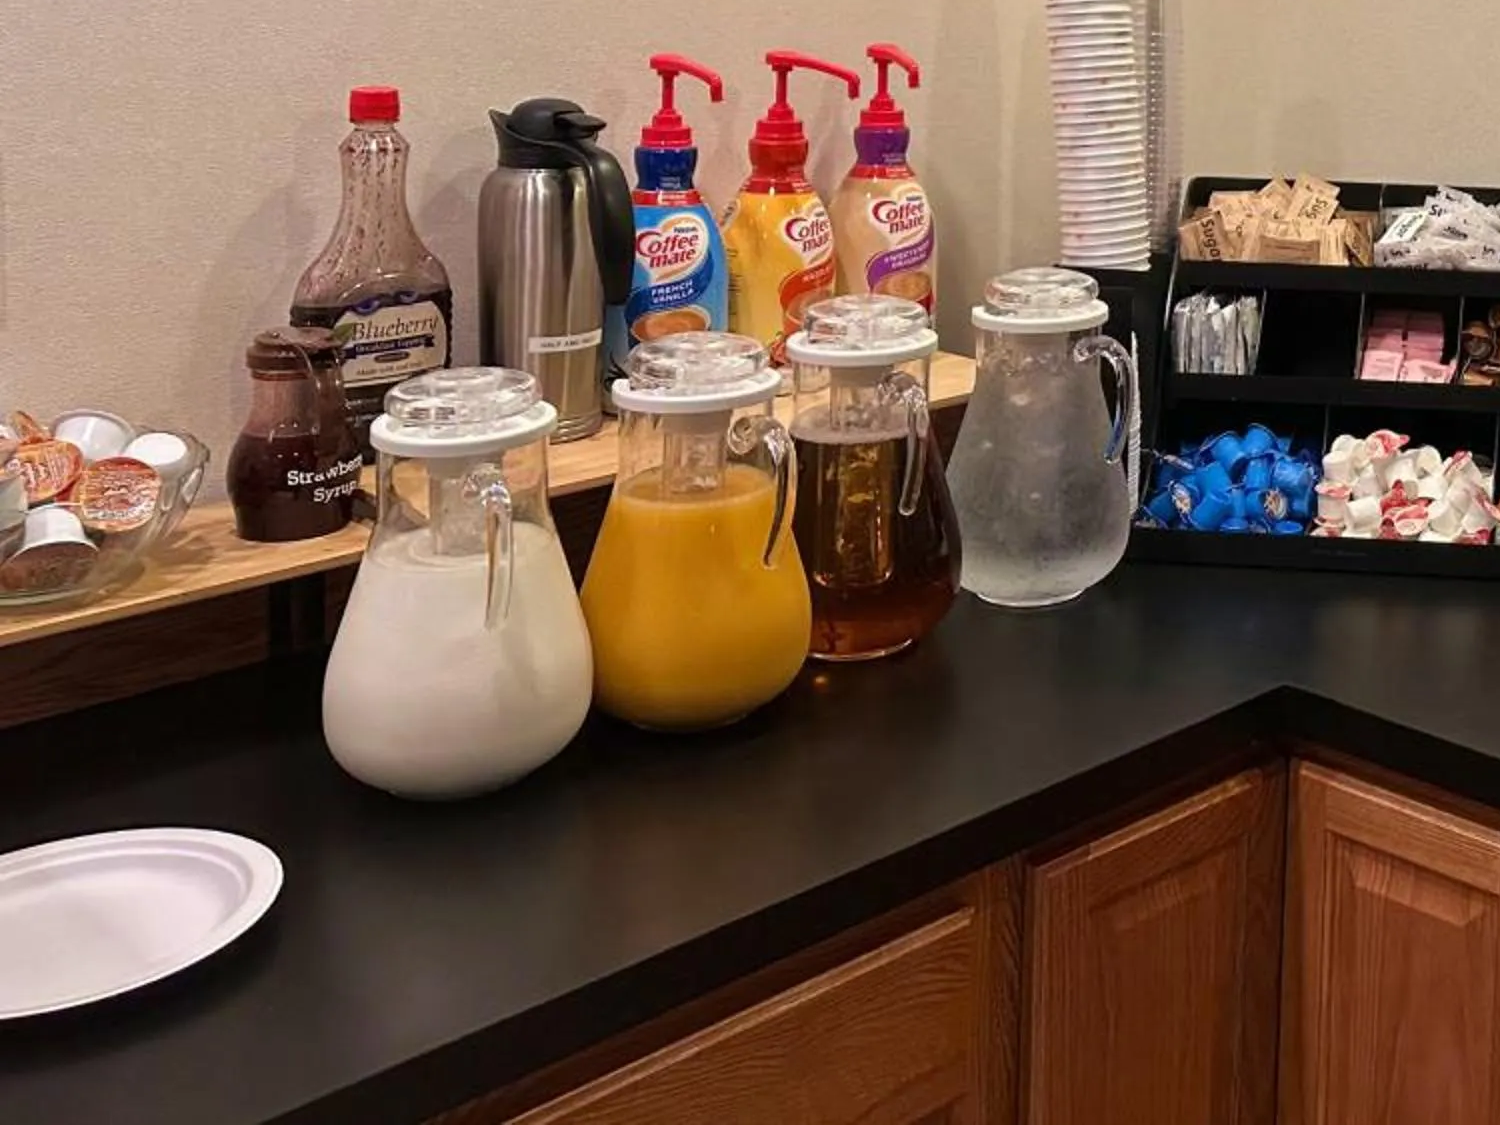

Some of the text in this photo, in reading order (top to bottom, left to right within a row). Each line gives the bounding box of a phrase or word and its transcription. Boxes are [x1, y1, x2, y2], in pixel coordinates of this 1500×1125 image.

[872, 200, 925, 224] Coffee
[636, 231, 699, 258] Coffee
[650, 249, 697, 268] mate
[651, 279, 693, 296] FRENCH
[352, 315, 439, 341] Blueberry
